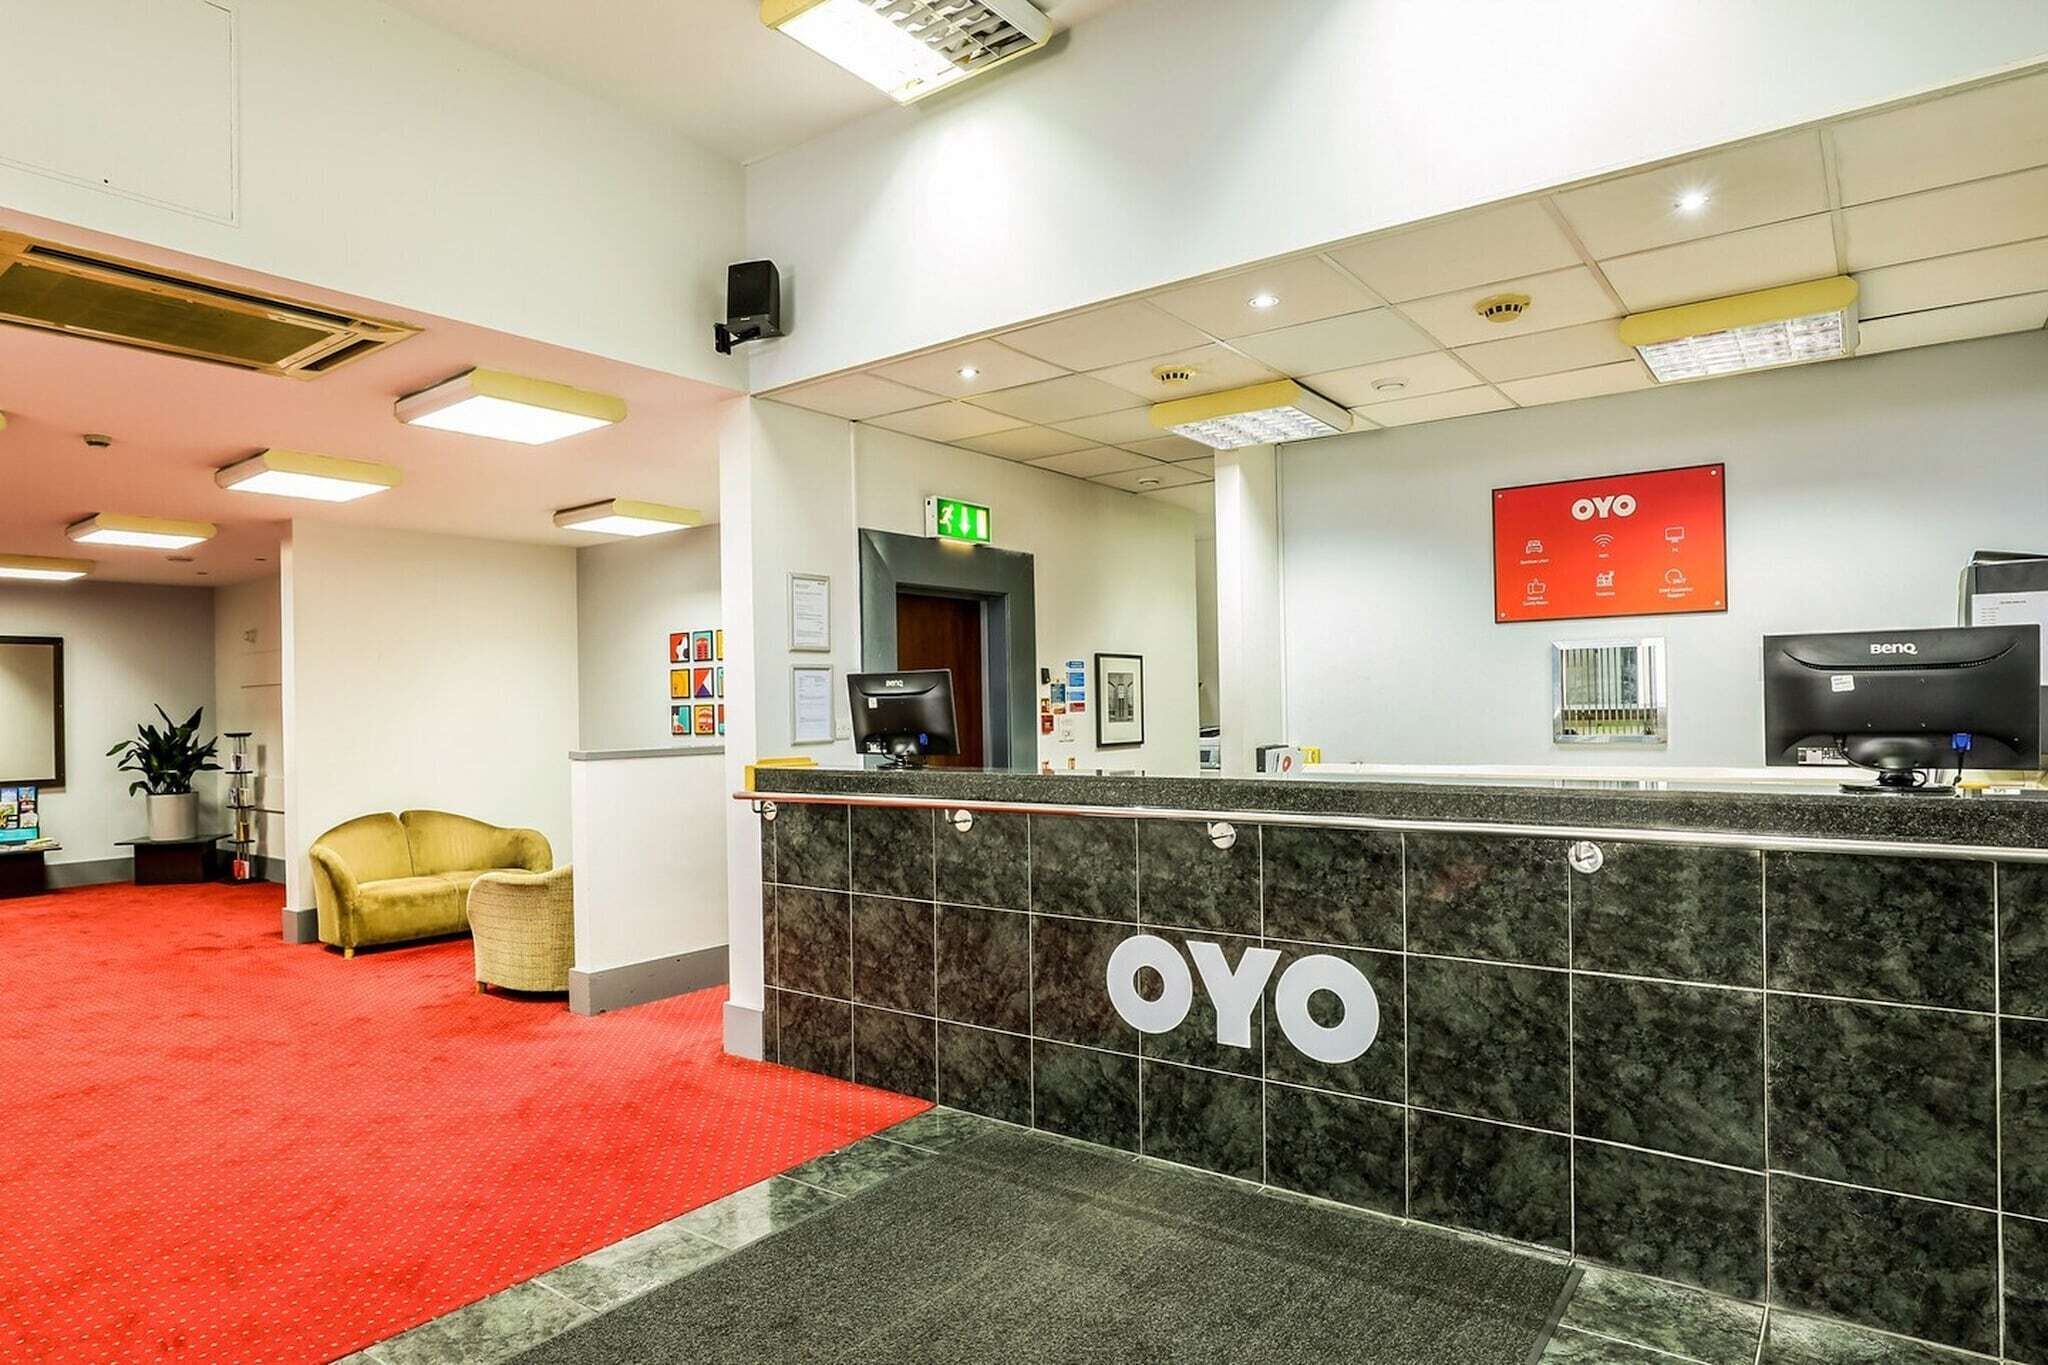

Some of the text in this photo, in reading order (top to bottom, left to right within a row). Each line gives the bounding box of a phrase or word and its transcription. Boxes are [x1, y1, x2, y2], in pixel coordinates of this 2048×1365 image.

[1572, 494, 1636, 521] OYO
[1870, 643, 1918, 655] BenQ
[1106, 934, 1380, 1064] OYO
